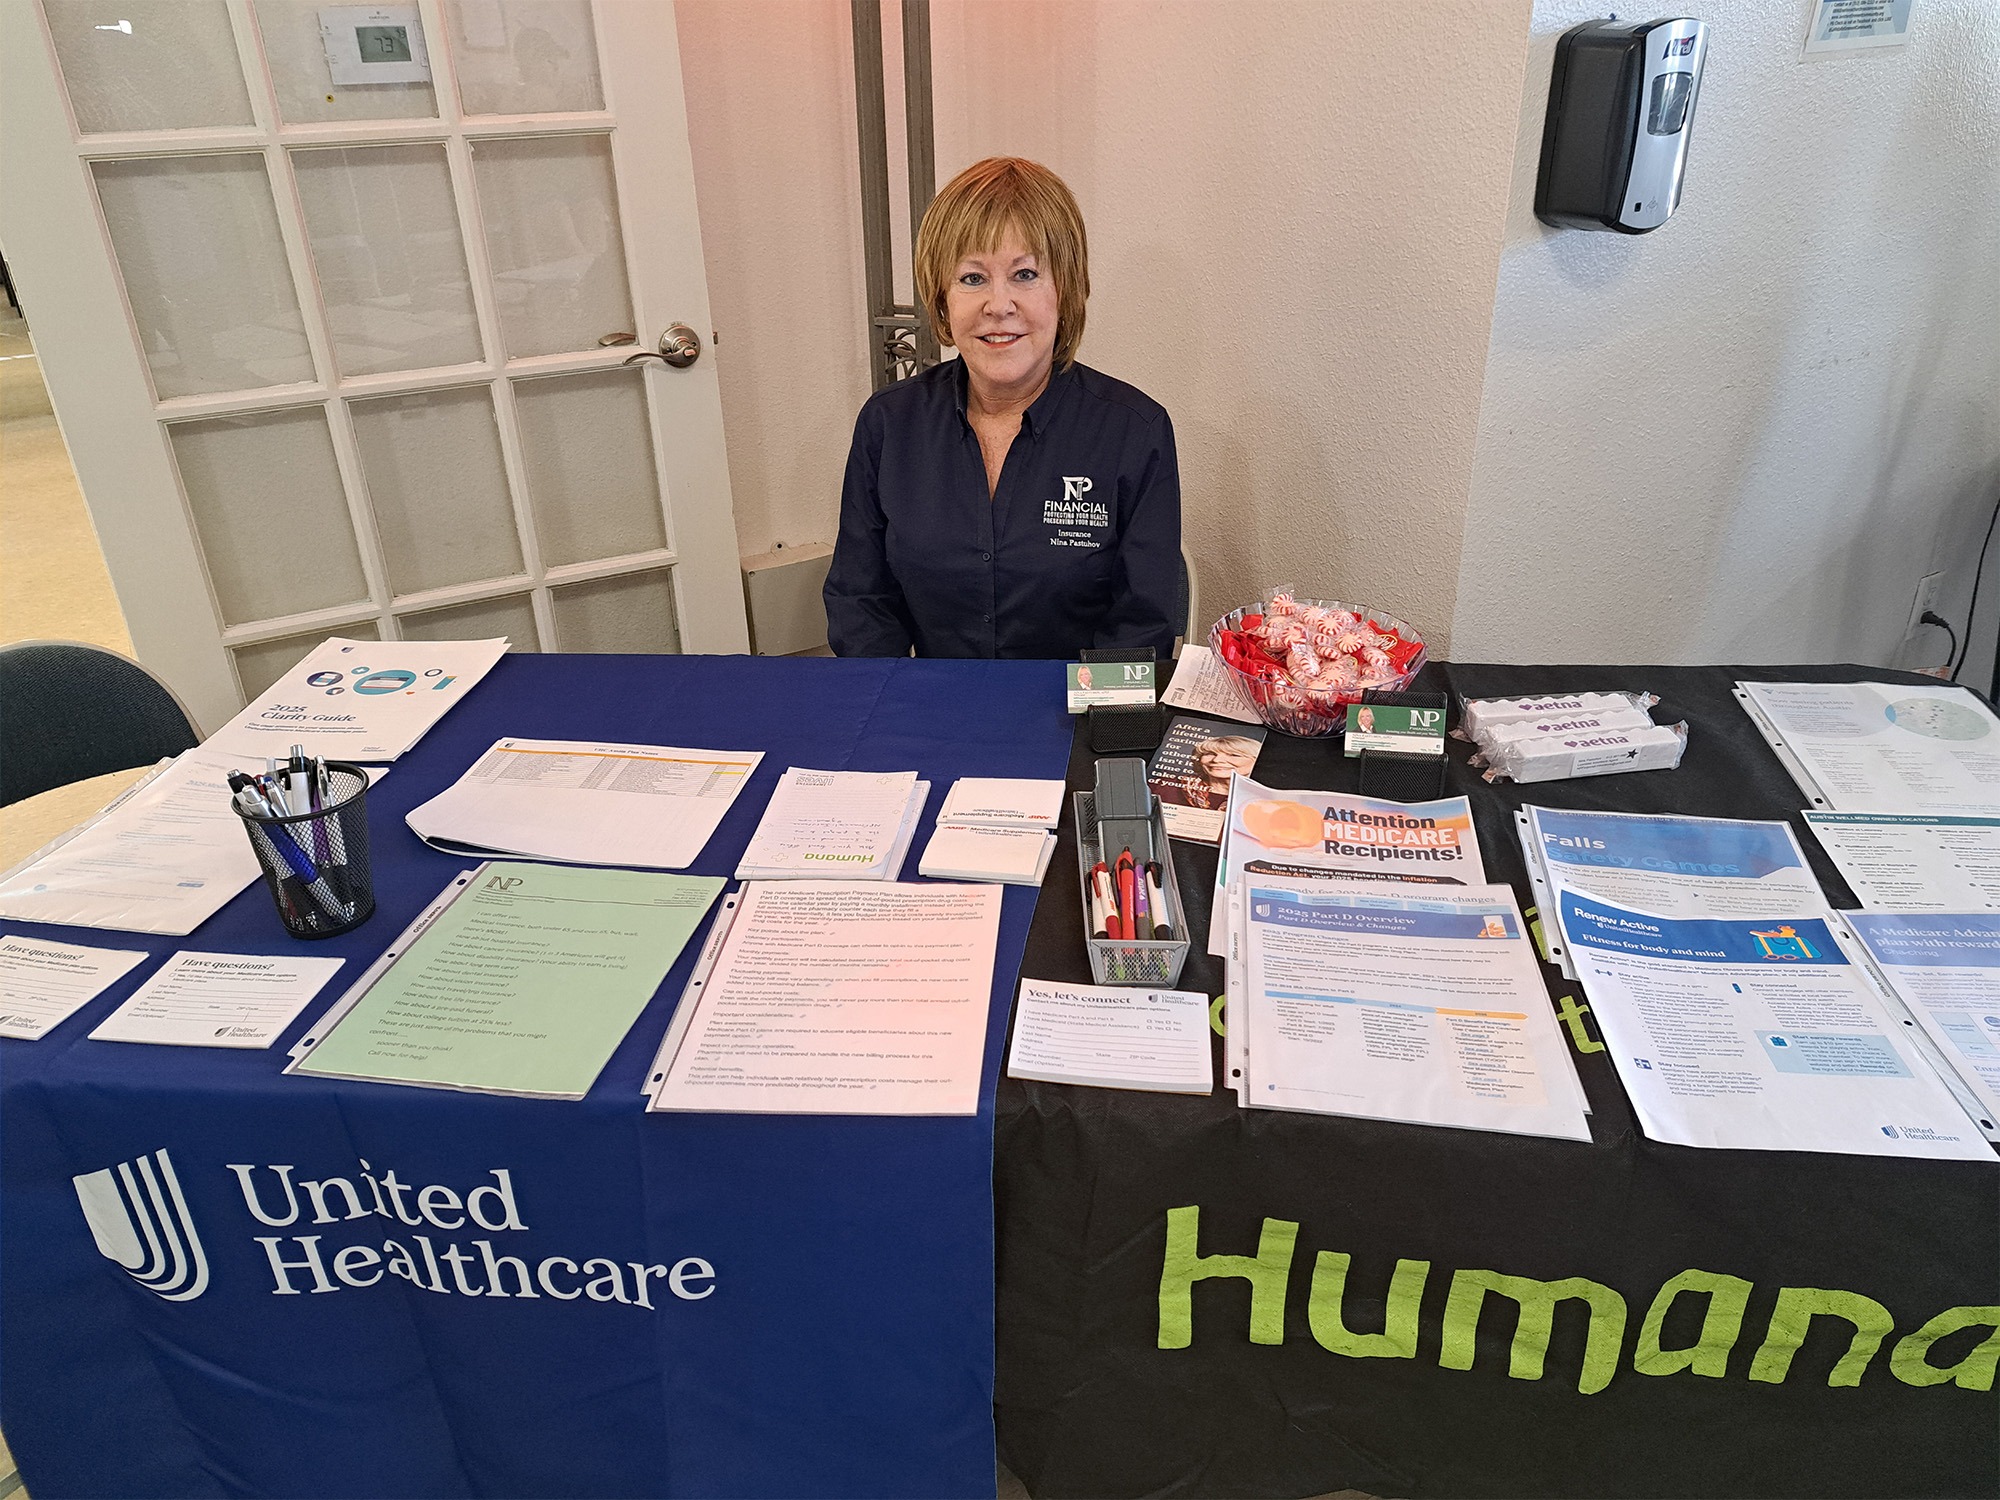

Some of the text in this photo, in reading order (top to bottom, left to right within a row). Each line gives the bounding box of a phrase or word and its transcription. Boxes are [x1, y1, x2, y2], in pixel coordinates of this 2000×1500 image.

[374, 37, 394, 53] 73
[1062, 476, 1093, 500] NP
[1044, 500, 1108, 514] FINANCIAL
[1043, 511, 1108, 521] PROTECTING YOUR HEALTH
[1043, 518, 1108, 527] PRESERVING YOUR WEALTH
[1058, 529, 1091, 538] Insurance
[1050, 538, 1100, 548] Nina Pastuhov
[1123, 664, 1150, 680] NP
[268, 704, 308, 713] 2025
[1533, 701, 1582, 711] aetna
[261, 712, 356, 722] Clarity Guide
[1410, 710, 1440, 727] NP
[1175, 724, 1203, 732] After
[1551, 719, 1600, 731] aetna
[1172, 730, 1214, 740] lifetime
[1168, 737, 1201, 747] caring
[1579, 736, 1629, 747] aetna
[1159, 756, 1183, 765] isn't
[1162, 750, 1199, 761] others,
[1155, 764, 1181, 772] time
[1151, 771, 1202, 783] take care
[1323, 806, 1436, 829] Attention
[1324, 822, 1455, 846] MEDICARE
[1542, 832, 1607, 850] Falls
[1325, 840, 1464, 862] Recipients!
[804, 853, 874, 862] Humana
[1548, 847, 1740, 874] Safety Games
[1249, 866, 1293, 877] Reduction
[1299, 867, 1334, 876] changes
[1335, 871, 1376, 879] mandated
[486, 876, 524, 890] NP
[1452, 896, 1496, 904] changes
[1277, 907, 1309, 918] 2025
[1312, 909, 1340, 920] Part
[1356, 914, 1416, 925] Overview
[1574, 907, 1660, 932] Renew Active
[1278, 914, 1298, 922] Part
[1310, 918, 1355, 928] Overview
[1366, 922, 1407, 931] Changes
[1604, 924, 1662, 938] UnitedHealthcare
[1869, 927, 2000, 938] A Medicare Advan
[1582, 933, 1726, 958] Fitness for body and mind
[1876, 938, 2000, 949] plan with reward
[2, 944, 84, 960] Have questions?
[181, 959, 275, 970] Have questions?
[1028, 989, 1131, 1005] Yes, let's connect
[1161, 998, 1199, 1006] Healthcare
[436, 1005, 466, 1014] pre-paid
[13, 1016, 37, 1024] United
[378, 1018, 398, 1026] These
[410, 1023, 423, 1031] just
[464, 1028, 498, 1036] problems
[1899, 1126, 1935, 1134] United
[1904, 1133, 1960, 1141] Healthcare
[224, 1158, 530, 1233] United
[253, 1235, 717, 1311] Healthcare
[1155, 1204, 2000, 1395] Humana
